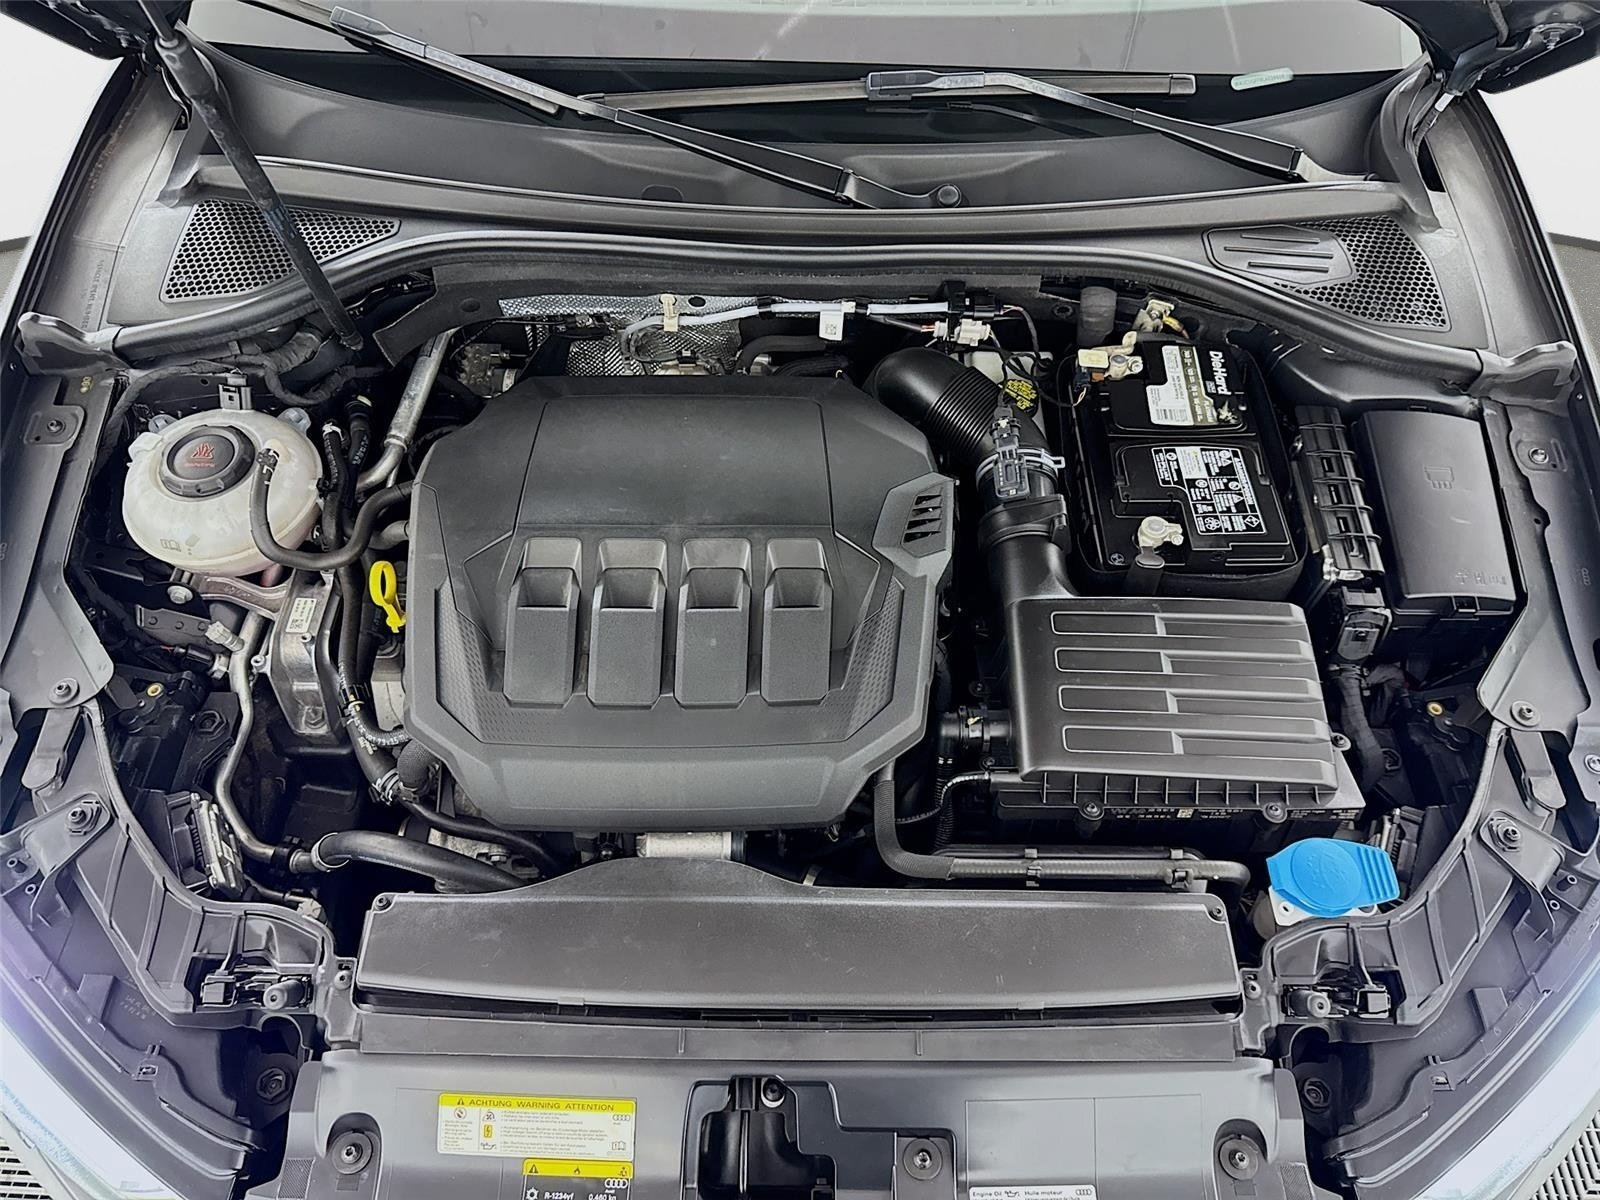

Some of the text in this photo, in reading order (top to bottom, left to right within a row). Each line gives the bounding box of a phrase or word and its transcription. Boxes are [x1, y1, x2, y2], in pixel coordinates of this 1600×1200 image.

[1209, 350, 1232, 396] DieHard
[469, 1099, 614, 1112] ACHTUNG WARNING ATTENTION
